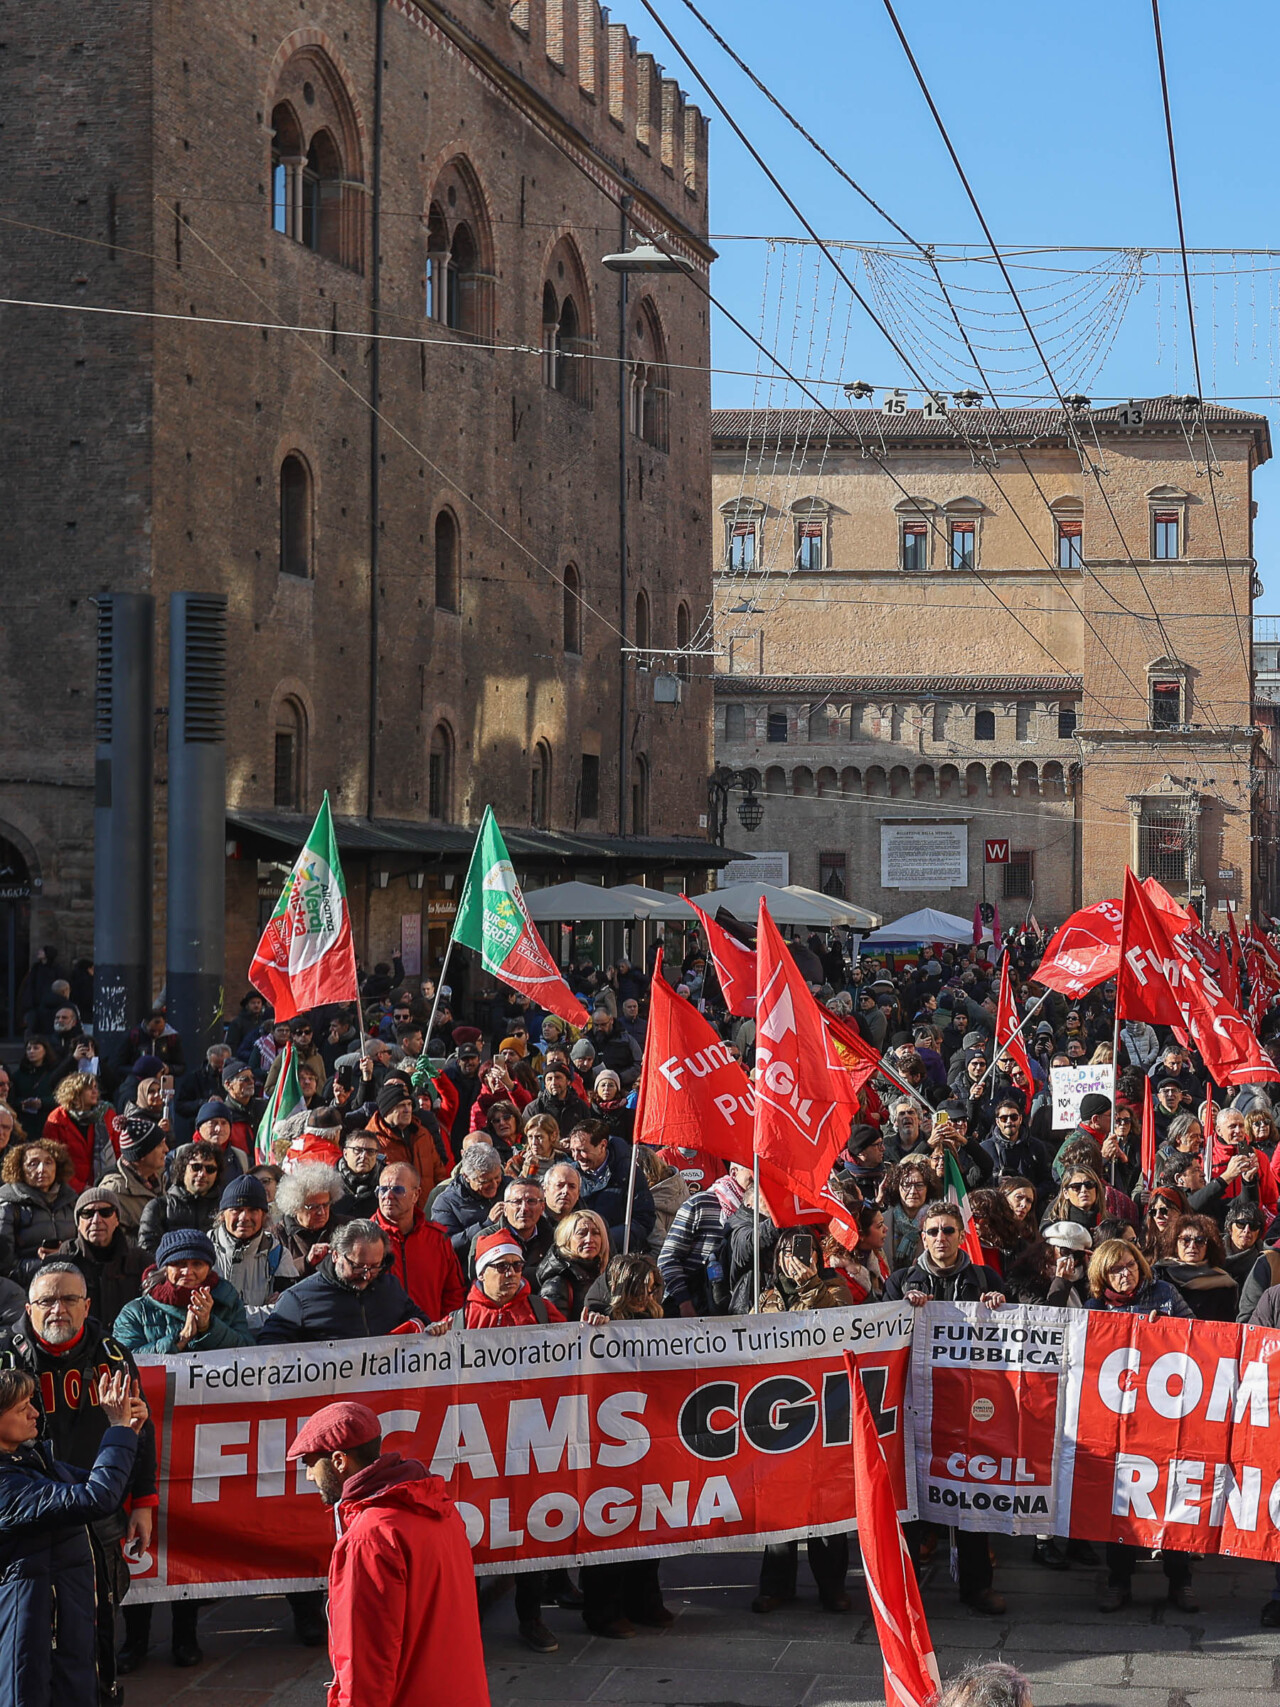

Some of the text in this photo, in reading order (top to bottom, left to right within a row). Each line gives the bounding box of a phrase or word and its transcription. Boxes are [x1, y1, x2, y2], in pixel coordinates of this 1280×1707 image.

[884, 399, 905, 414] 15
[924, 401, 948, 417] 14
[1120, 409, 1143, 425] 13
[987, 844, 1006, 859] W
[304, 885, 326, 934] Verdi
[321, 883, 335, 932] Alleanza
[755, 1047, 813, 1126] CGIL
[933, 1325, 1063, 1346] FUNZIONE
[189, 1313, 914, 1389] Federazione Italiana Lavoratori Commercio Turismo e Serviz
[932, 1346, 1060, 1365] PUBBLICA
[678, 1366, 897, 1462] CGIL
[946, 1452, 1035, 1482] CGIL
[454, 1475, 742, 1550] OLOGNA
[928, 1485, 1048, 1514] BOLOGNA
